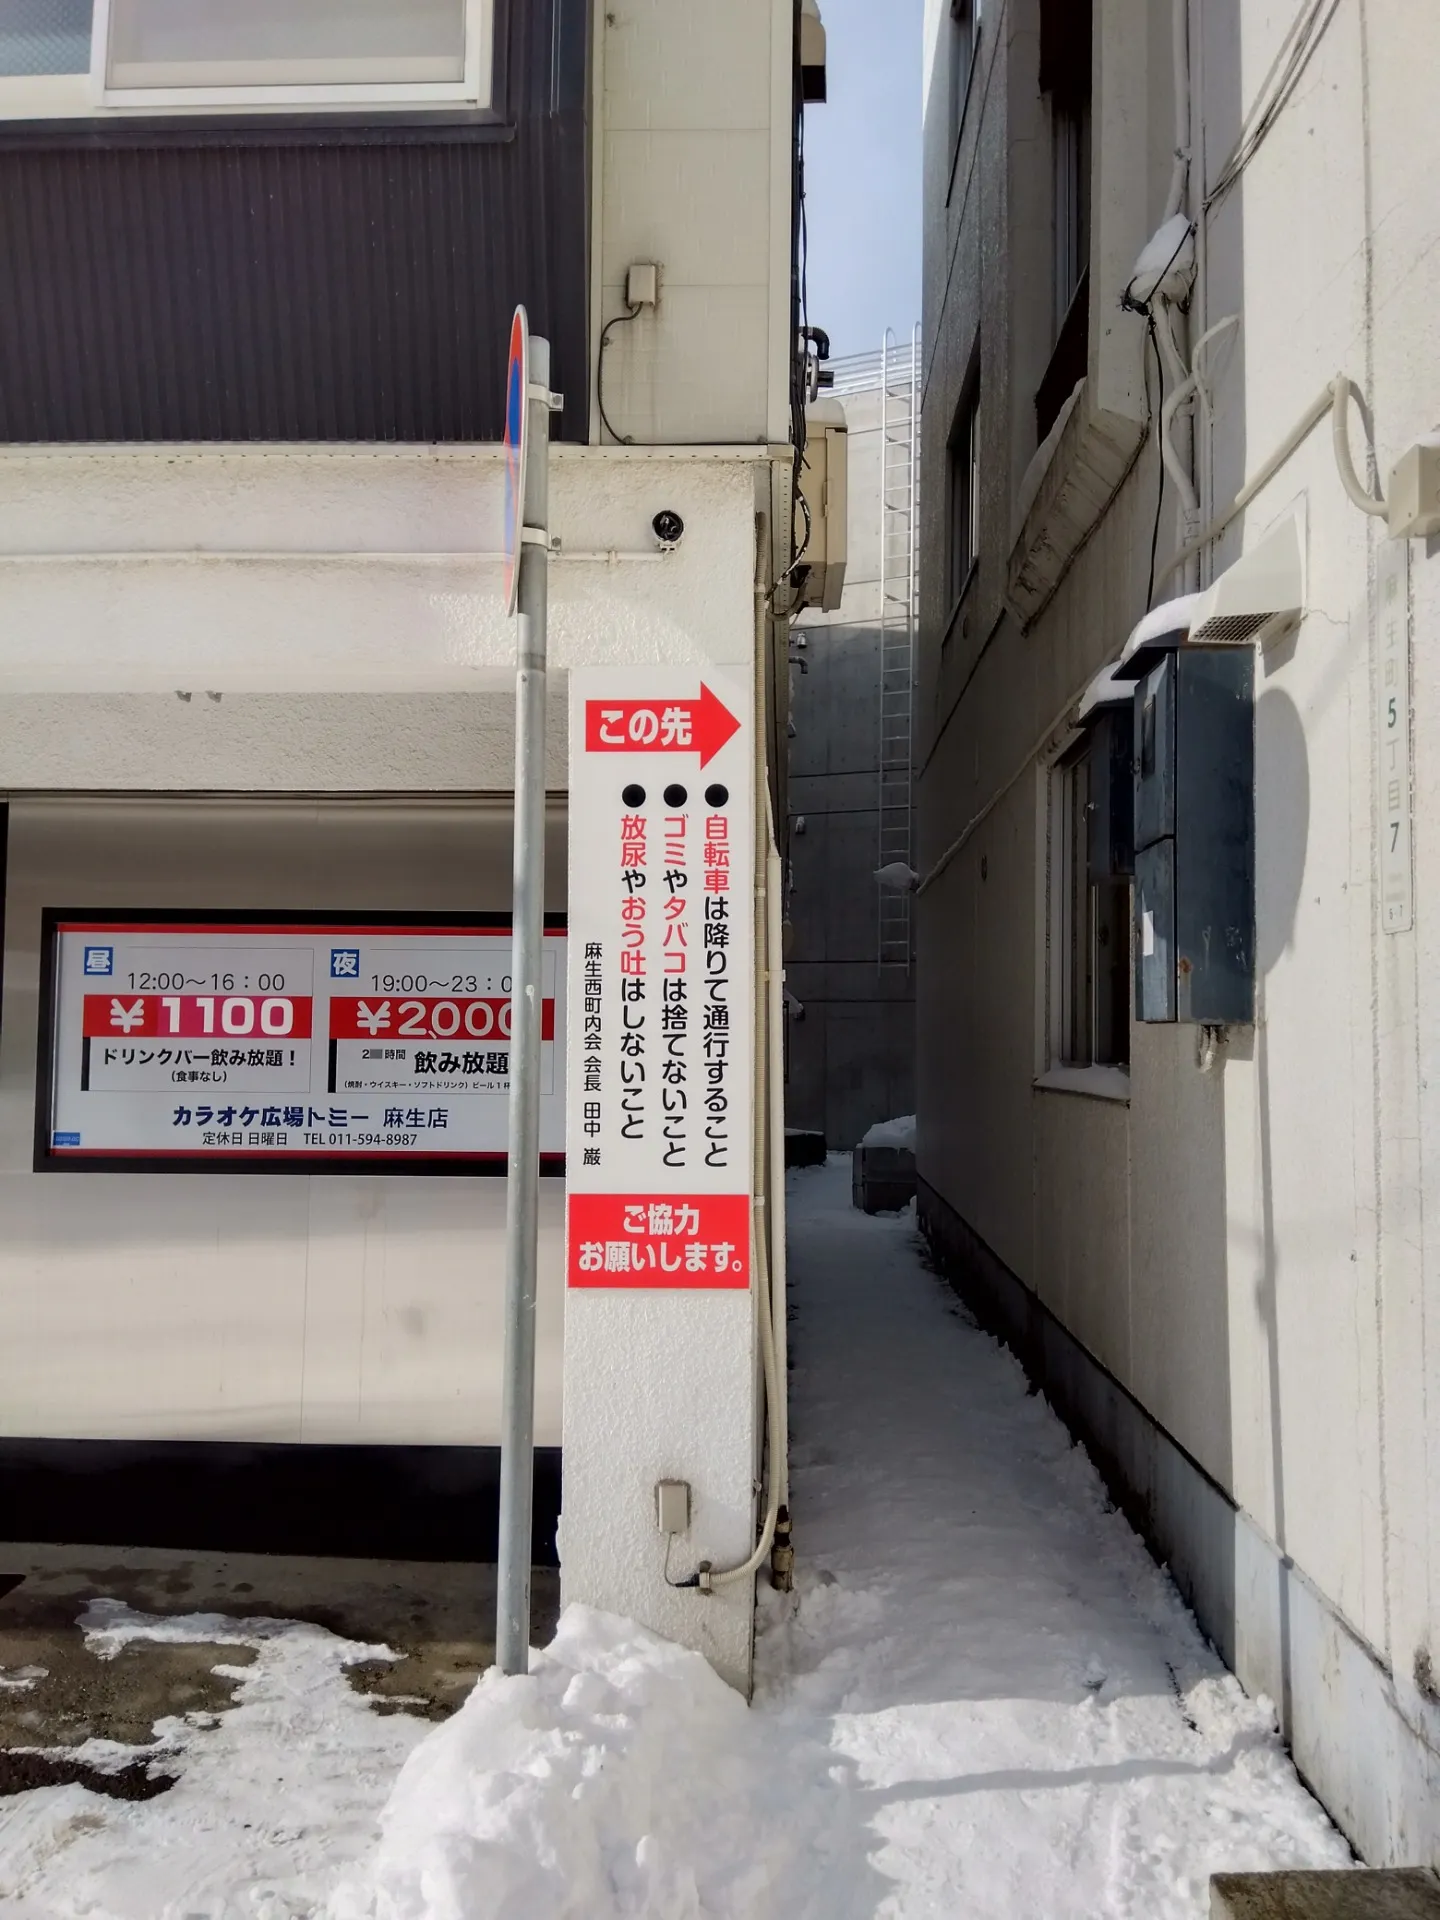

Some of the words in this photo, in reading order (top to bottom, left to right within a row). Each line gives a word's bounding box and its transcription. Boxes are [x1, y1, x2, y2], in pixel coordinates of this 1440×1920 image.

[599, 707, 692, 746] この先
[86, 950, 111, 973] 昼
[333, 951, 358, 976] 夜
[620, 814, 647, 1139] 放尿やおう吐はしないこと
[371, 974, 513, 993] 19:00～23：0
[584, 942, 602, 1051] 麻生西町内会
[662, 813, 689, 1168] ゴミやタバコは捨てないこと
[703, 814, 730, 1168] 自転車は降りて通行すること
[110, 997, 294, 1036] ¥1100
[103, 1048, 296, 1067] ドリンクバー飲み放題！
[414, 1051, 509, 1075] 飲み放題
[583, 1055, 602, 1092] 会長
[171, 1070, 227, 1083] (食事なし)
[173, 1105, 370, 1128] カラオケ広場トミー
[382, 1107, 449, 1129] 麻生店
[583, 1102, 601, 1138] 田中
[202, 1132, 243, 1146] 定休日
[248, 1132, 288, 1147] 日曜日
[304, 1133, 326, 1146] TEL
[328, 1133, 418, 1147] 011-594-8987
[622, 1203, 700, 1236] ご協力
[578, 1241, 742, 1272] お願いします。
